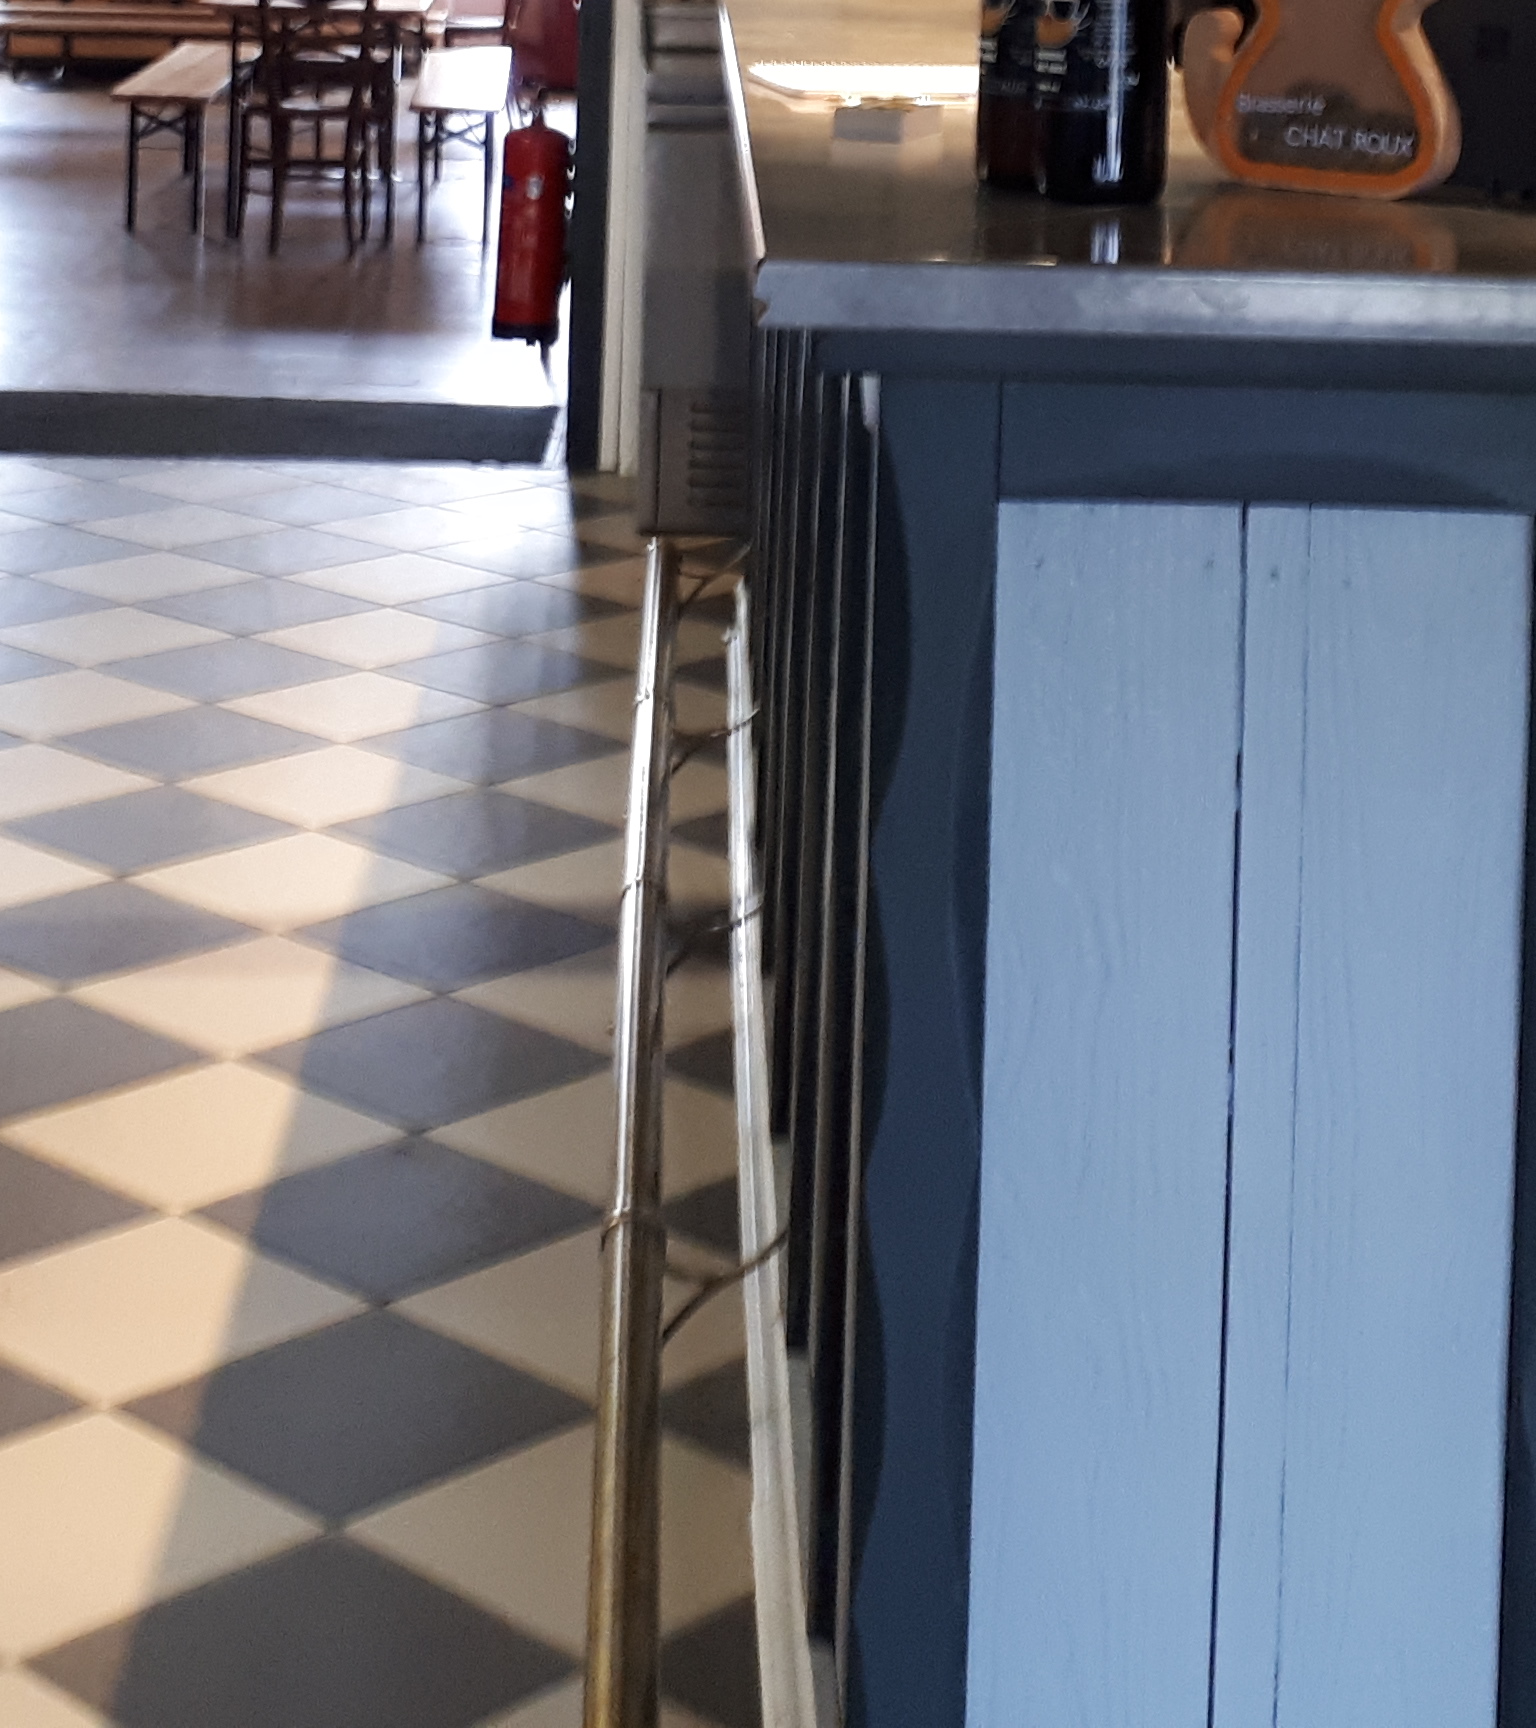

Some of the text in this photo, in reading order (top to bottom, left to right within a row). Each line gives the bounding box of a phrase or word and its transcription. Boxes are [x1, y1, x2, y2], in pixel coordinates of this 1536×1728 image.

[1234, 89, 1325, 115] Brasserie
[1283, 122, 1413, 157] CHAT ROUX
